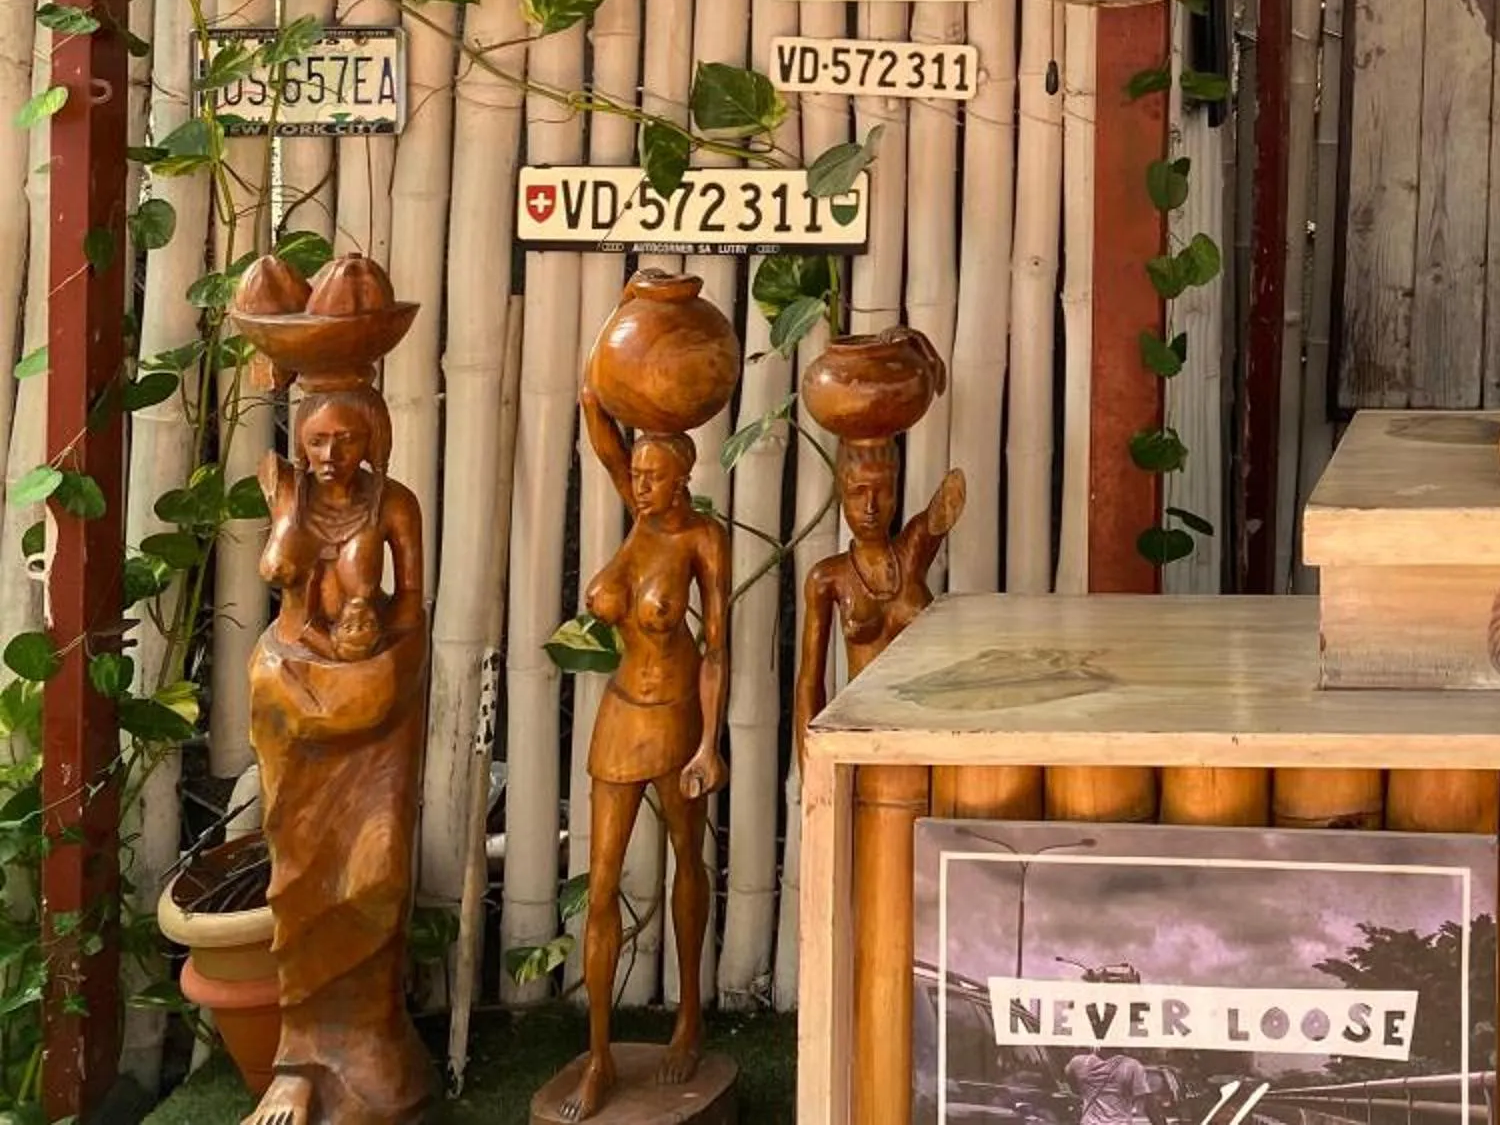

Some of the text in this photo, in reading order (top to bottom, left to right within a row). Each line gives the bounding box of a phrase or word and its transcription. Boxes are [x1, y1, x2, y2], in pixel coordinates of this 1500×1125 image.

[698, 244, 711, 254] SA
[1008, 997, 1407, 1047] NEVER LOOSE
